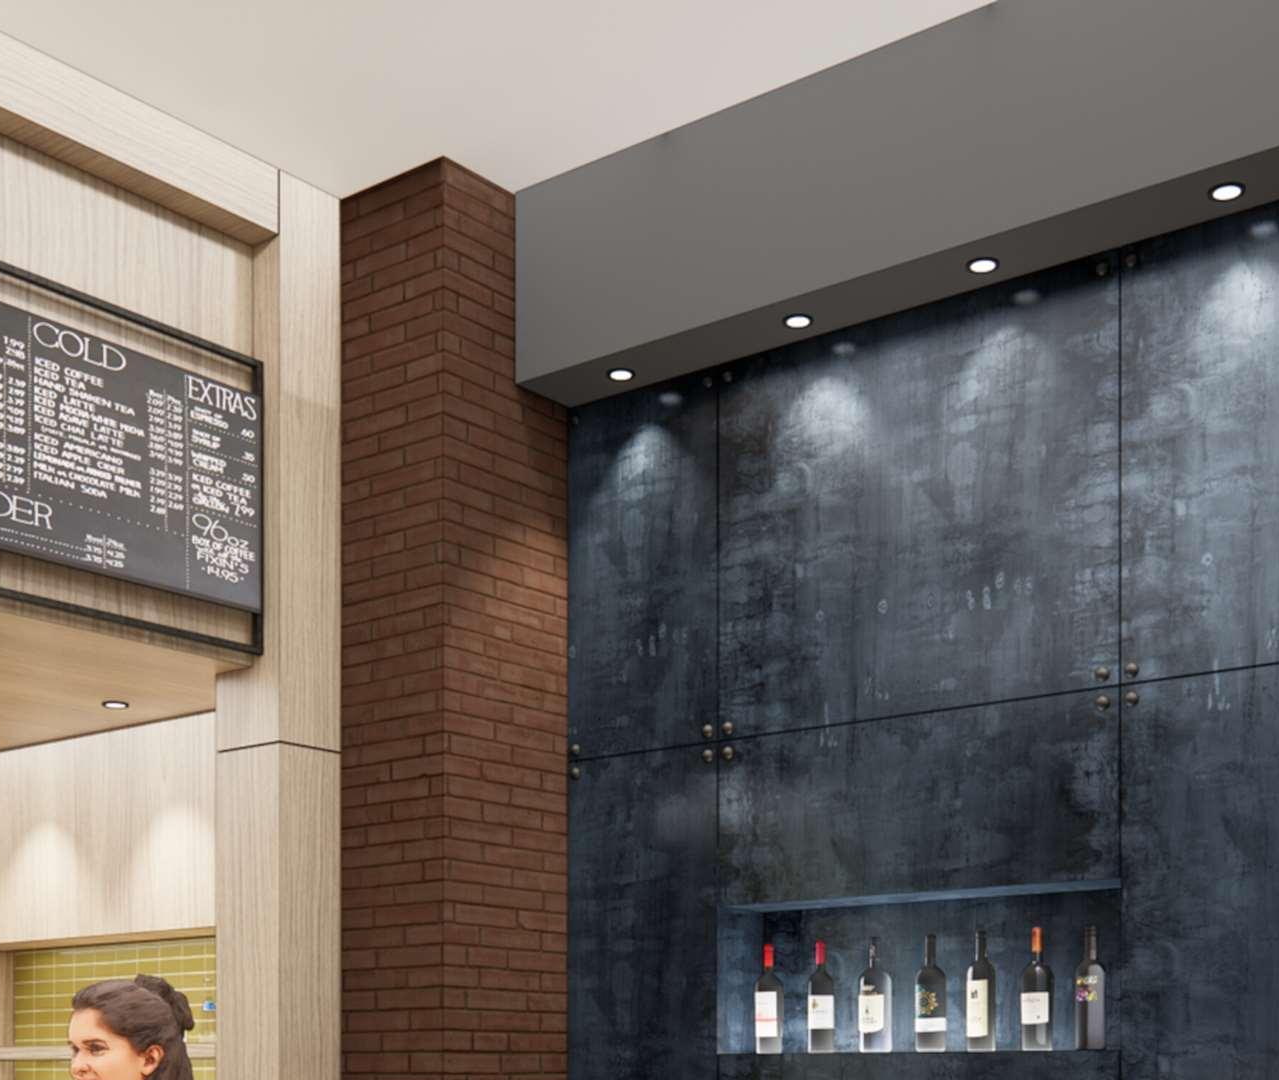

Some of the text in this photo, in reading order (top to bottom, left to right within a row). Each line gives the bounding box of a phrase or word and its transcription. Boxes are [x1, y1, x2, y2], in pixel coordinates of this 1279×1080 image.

[33, 322, 127, 371] COLD
[33, 366, 60, 381] ICED
[64, 375, 86, 391] TEA
[34, 356, 61, 373] ICED
[63, 367, 103, 388] COFFEE
[33, 375, 66, 393] HAND
[114, 402, 136, 417] TEA
[33, 385, 58, 400] ICED
[63, 395, 96, 413] LATTE
[33, 394, 56, 409] ICED
[188, 376, 257, 420] EXTRAS
[33, 403, 56, 417] ICED
[58, 412, 89, 428] AGAVE
[93, 423, 125, 440] LATTE
[34, 413, 58, 428] ICED
[59, 422, 86, 436] CHAI
[90, 431, 124, 448] LATTE
[189, 409, 229, 429] ESPRESSO
[33, 432, 59, 446] ICED
[63, 441, 123, 466] AMERICANO
[33, 442, 59, 455] ICED
[61, 450, 91, 466] APPLE
[96, 460, 125, 475] CIDER
[33, 451, 76, 470] LEMONADE
[32, 460, 56, 474] MILK
[68, 471, 116, 491] CHOCOLATE
[118, 485, 141, 498] MILK
[33, 470, 108, 499] ITALIAN SODA
[191, 472, 214, 488] ICED
[215, 480, 251, 499] COFFEE
[202, 484, 224, 498] ICED
[226, 491, 248, 506] TEA
[192, 513, 249, 551] 96oz
[191, 534, 211, 549] BOX
[211, 540, 223, 552] OF
[223, 544, 255, 562] COFFEE
[196, 551, 249, 574] FIXIN'S
